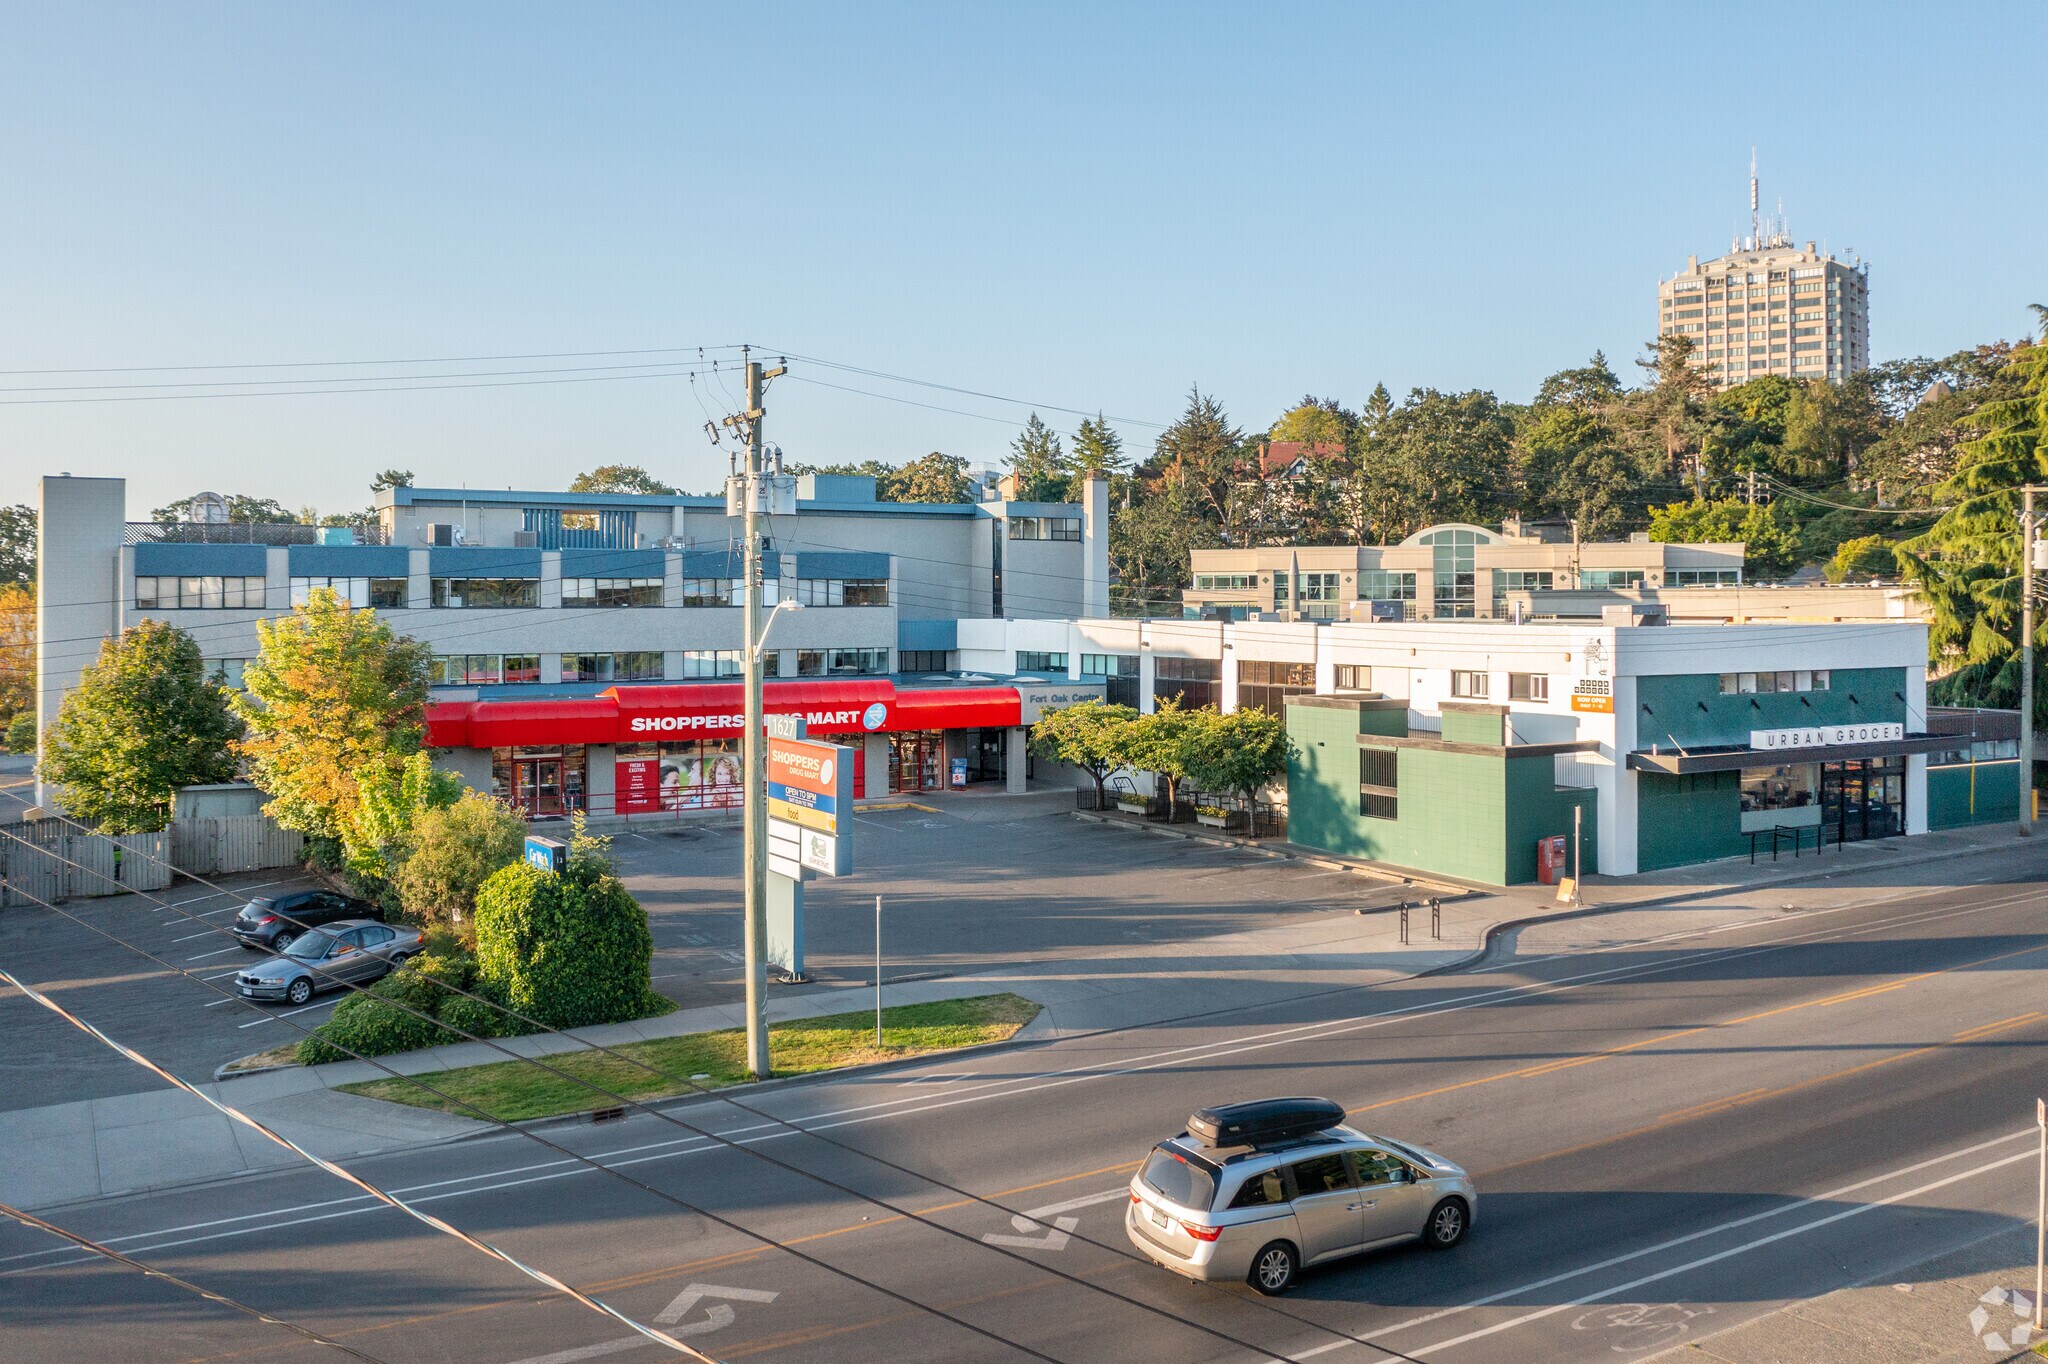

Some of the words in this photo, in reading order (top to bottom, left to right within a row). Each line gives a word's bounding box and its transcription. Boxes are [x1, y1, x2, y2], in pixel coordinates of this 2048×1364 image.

[1030, 694, 1047, 703] Fort
[1051, 693, 1068, 703] Oak
[631, 714, 745, 731] SHOPPERS
[807, 710, 861, 725] MART
[772, 718, 795, 736] 1627
[1768, 733, 1824, 746] URBAN
[1836, 727, 1900, 742] GROCER
[772, 749, 820, 771] SHOPPERS
[789, 766, 804, 776] DRUG
[804, 770, 819, 780] MART
[785, 786, 798, 796] OPEN
[799, 789, 806, 798] TO
[788, 807, 799, 820] food
